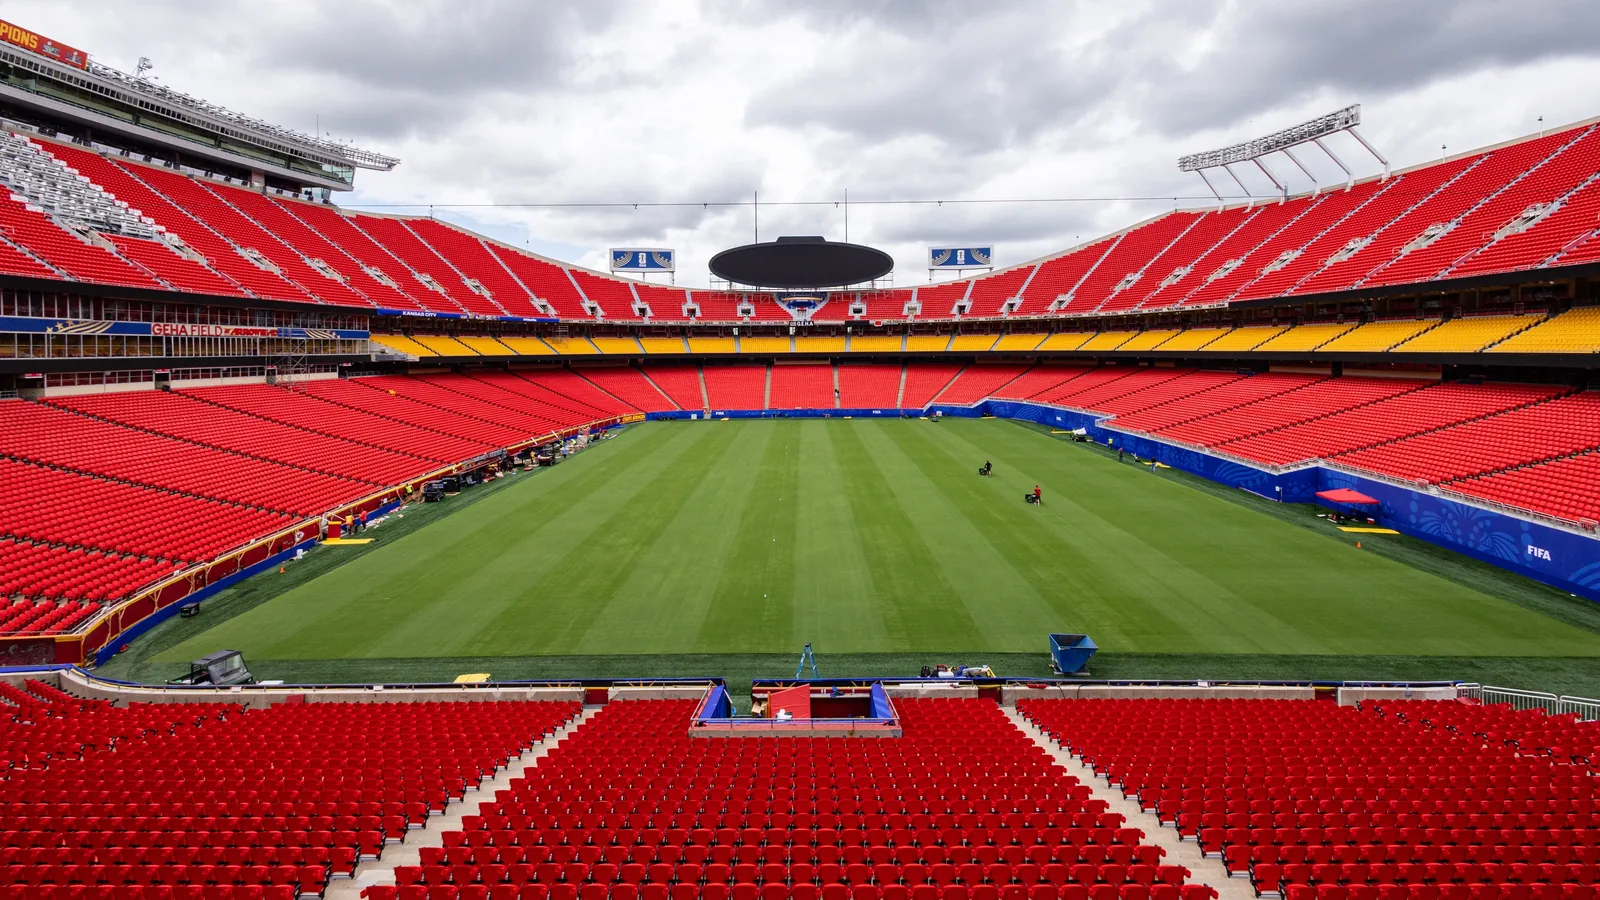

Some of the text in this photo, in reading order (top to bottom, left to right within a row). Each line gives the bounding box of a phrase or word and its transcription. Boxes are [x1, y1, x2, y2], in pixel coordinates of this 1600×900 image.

[152, 323, 188, 336] GEHA
[191, 325, 222, 337] FIELD
[1527, 544, 1551, 561] FIFA
